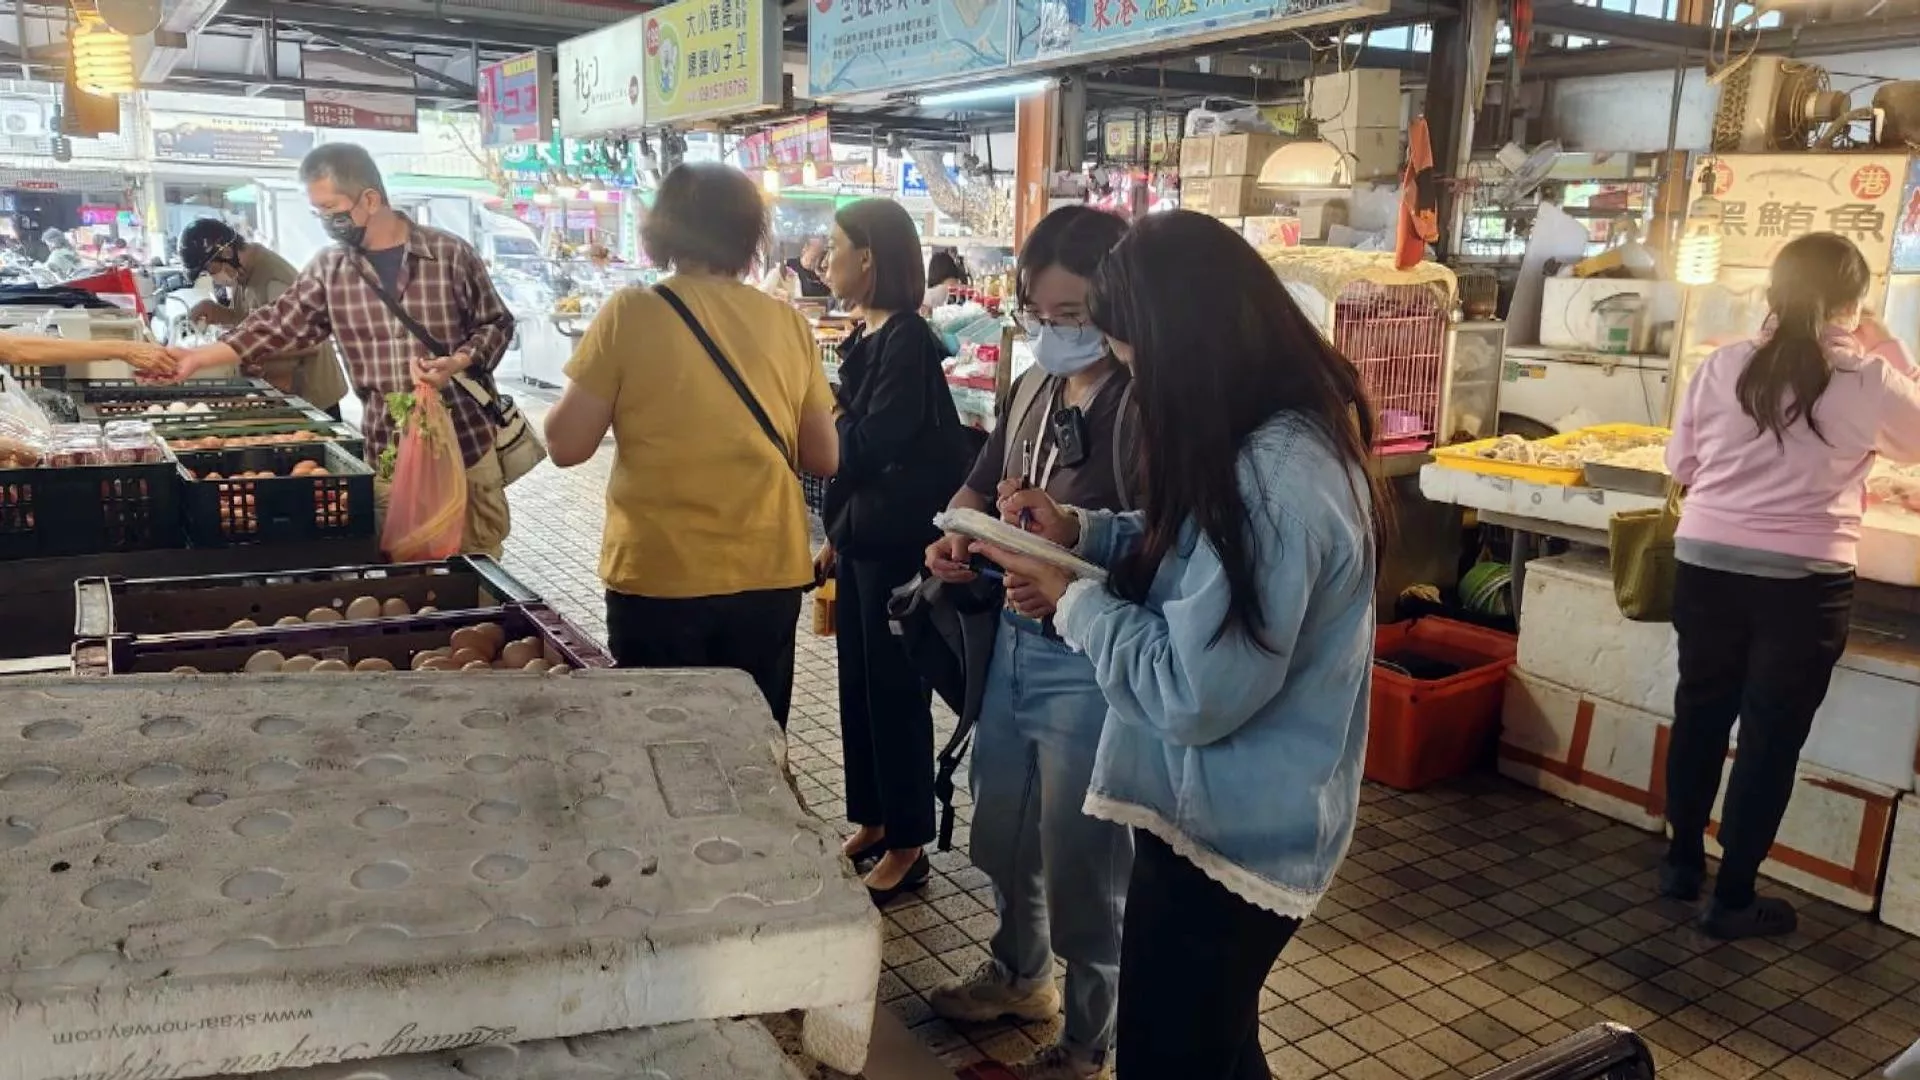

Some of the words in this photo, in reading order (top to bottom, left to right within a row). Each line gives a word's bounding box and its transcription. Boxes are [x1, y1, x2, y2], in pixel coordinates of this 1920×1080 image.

[1854, 165, 1889, 197] 港
[1719, 200, 1886, 242] 黑鮪魚
[52, 1007, 313, 1046] www.skaar-norway.com
